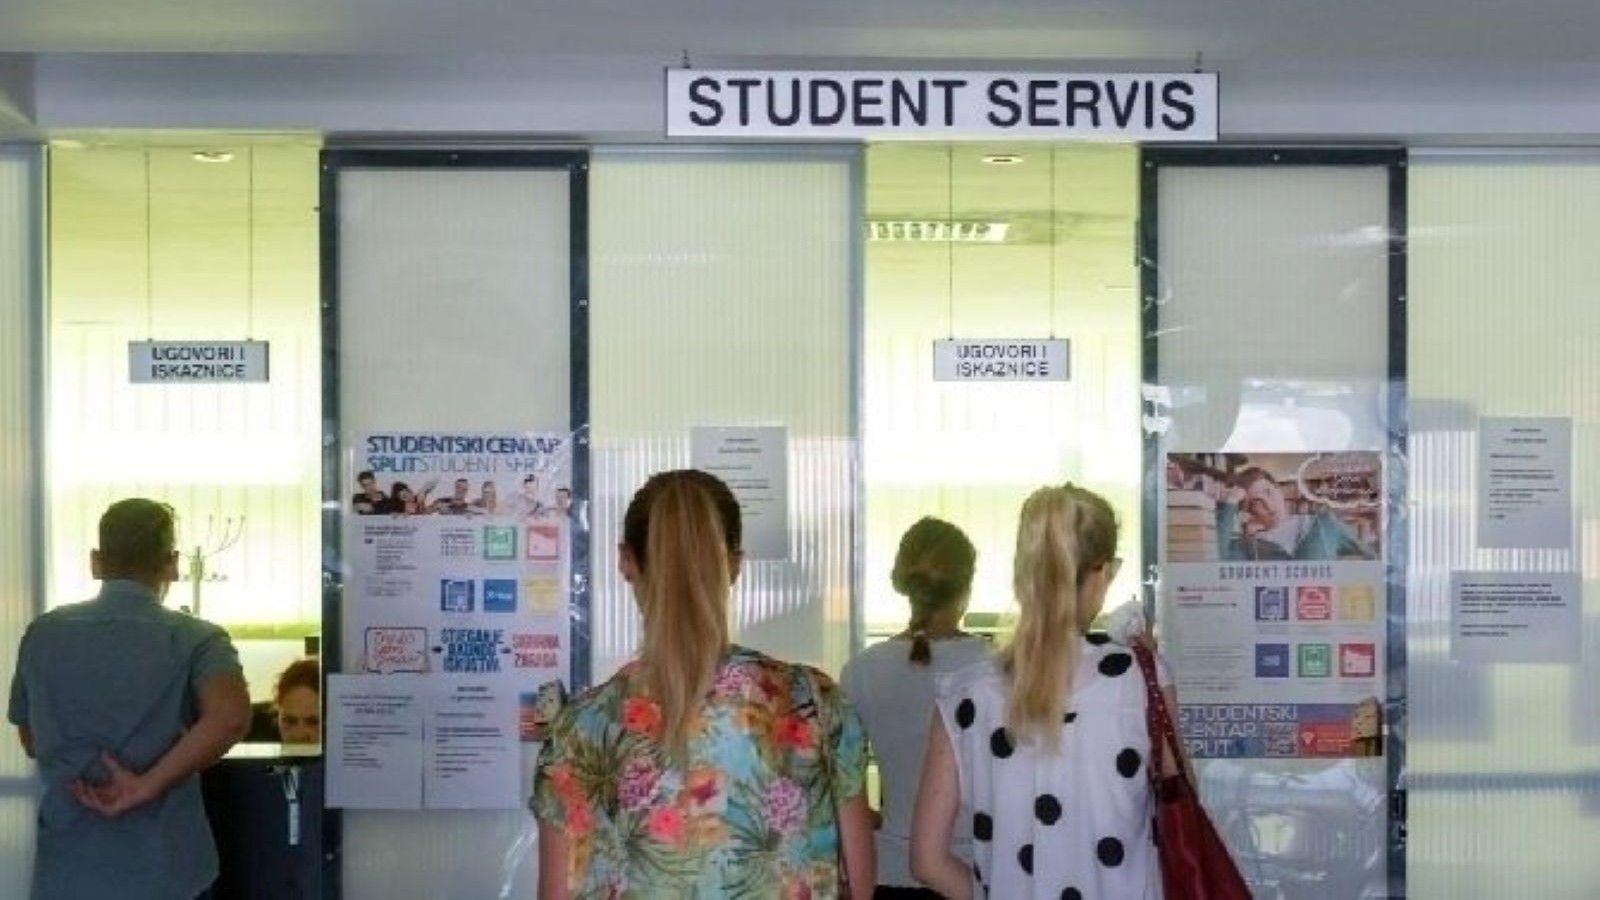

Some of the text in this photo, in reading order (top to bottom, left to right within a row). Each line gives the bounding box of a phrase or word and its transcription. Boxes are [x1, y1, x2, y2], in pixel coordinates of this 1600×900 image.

[688, 77, 1197, 131] STUDENT SERVIS
[151, 346, 234, 361] UGOVORI
[957, 345, 1036, 359] UGOVORI
[151, 363, 246, 379] ISKAZNICE
[956, 362, 1050, 377] ISKAZNICE
[367, 435, 483, 454] STUDENTSKI
